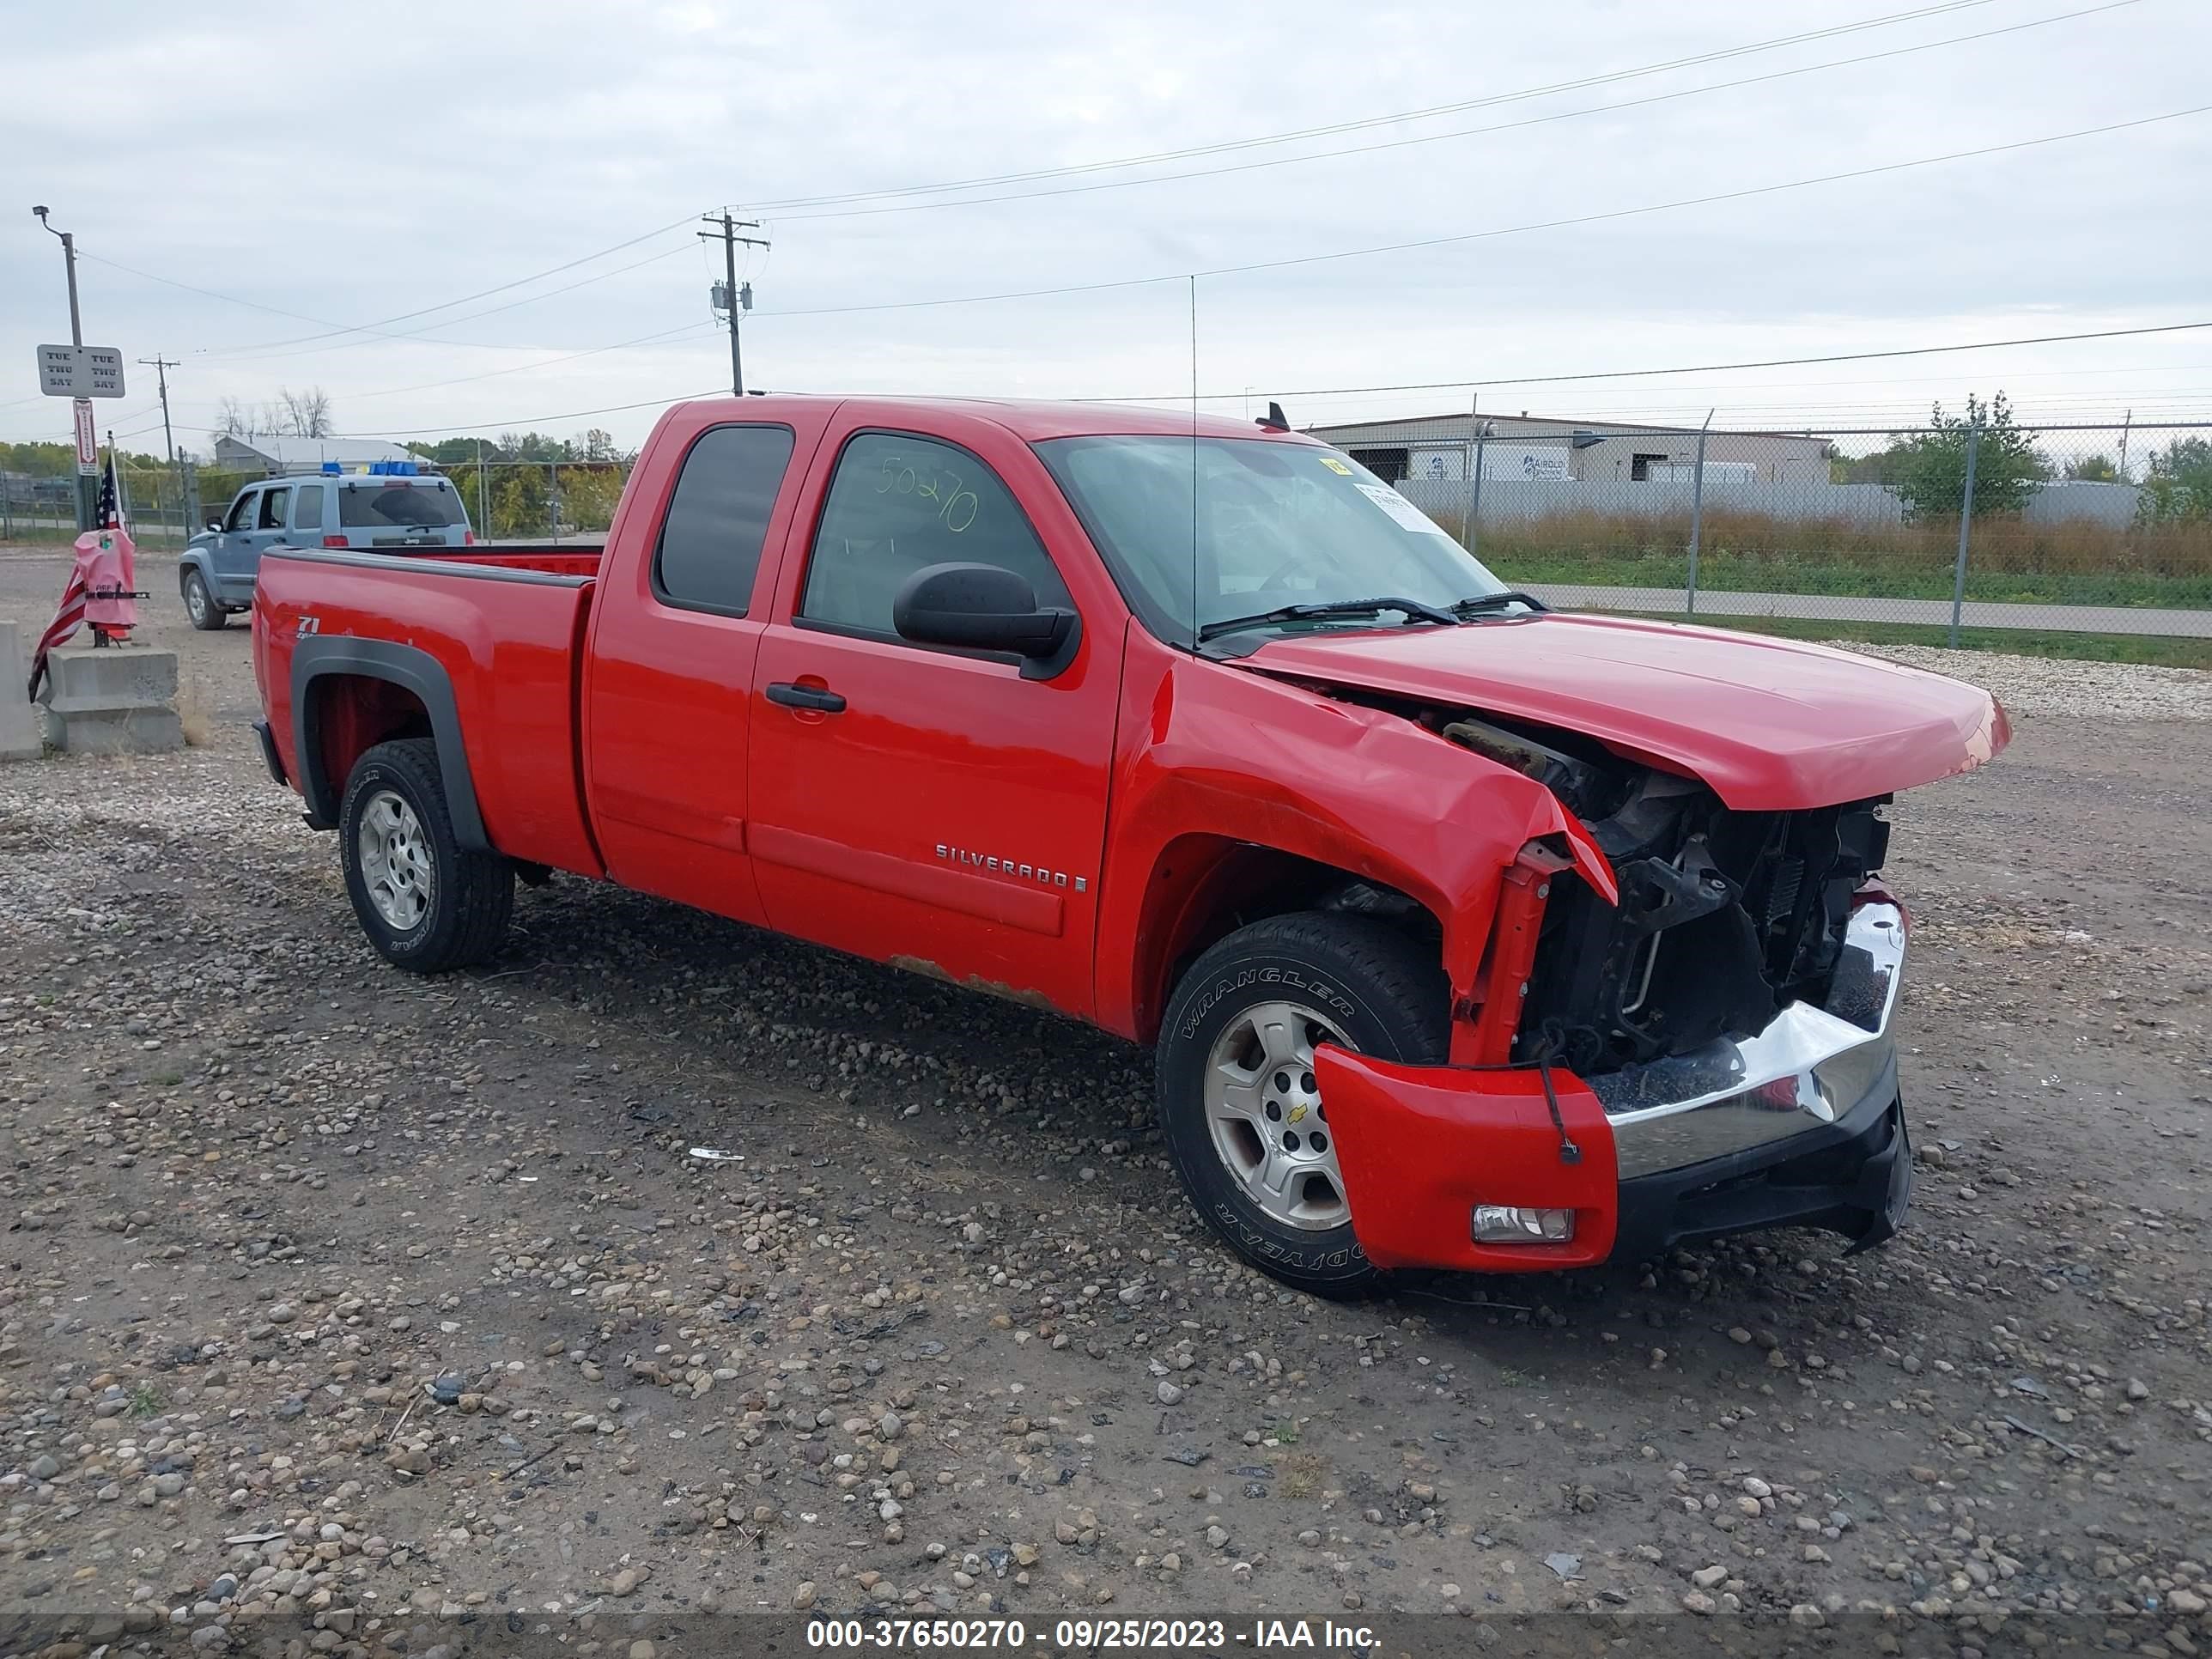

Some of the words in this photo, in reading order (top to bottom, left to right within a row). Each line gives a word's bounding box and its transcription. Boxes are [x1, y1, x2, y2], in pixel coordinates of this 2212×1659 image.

[46, 352, 71, 361] TUE
[91, 355, 115, 364] TUE
[47, 365, 72, 374] THU
[91, 368, 117, 376] THU
[50, 378, 73, 386] SAT
[94, 380, 116, 389] SAT
[874, 457, 979, 532] 50270
[935, 844, 1067, 888] SILVERADO
[1181, 967, 1357, 1040] WRANGLER
[1214, 1201, 1368, 1272] ODYEAR
